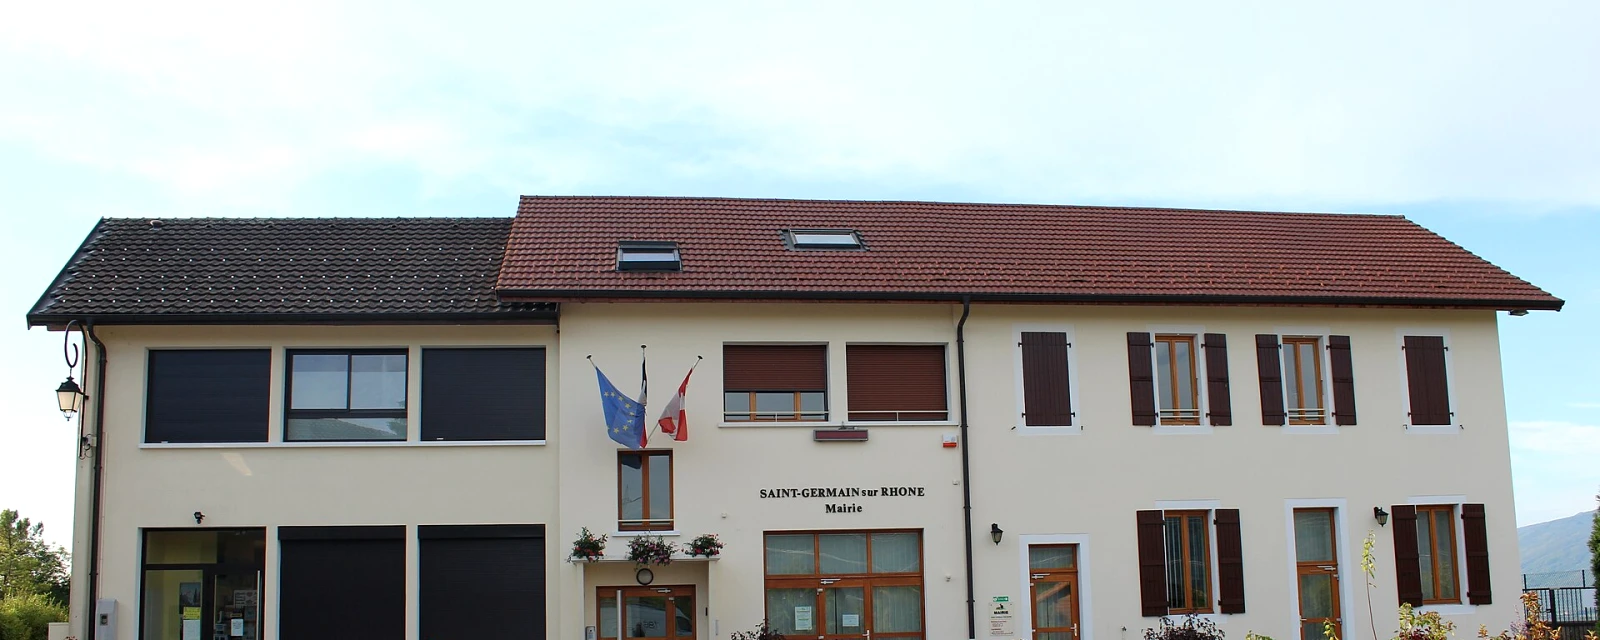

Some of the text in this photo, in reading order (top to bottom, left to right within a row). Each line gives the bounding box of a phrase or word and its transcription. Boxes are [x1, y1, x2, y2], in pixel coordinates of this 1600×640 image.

[760, 488, 860, 499] SAINT-GERMAIN
[881, 487, 925, 497] RHONE
[825, 503, 863, 513] Mairie
